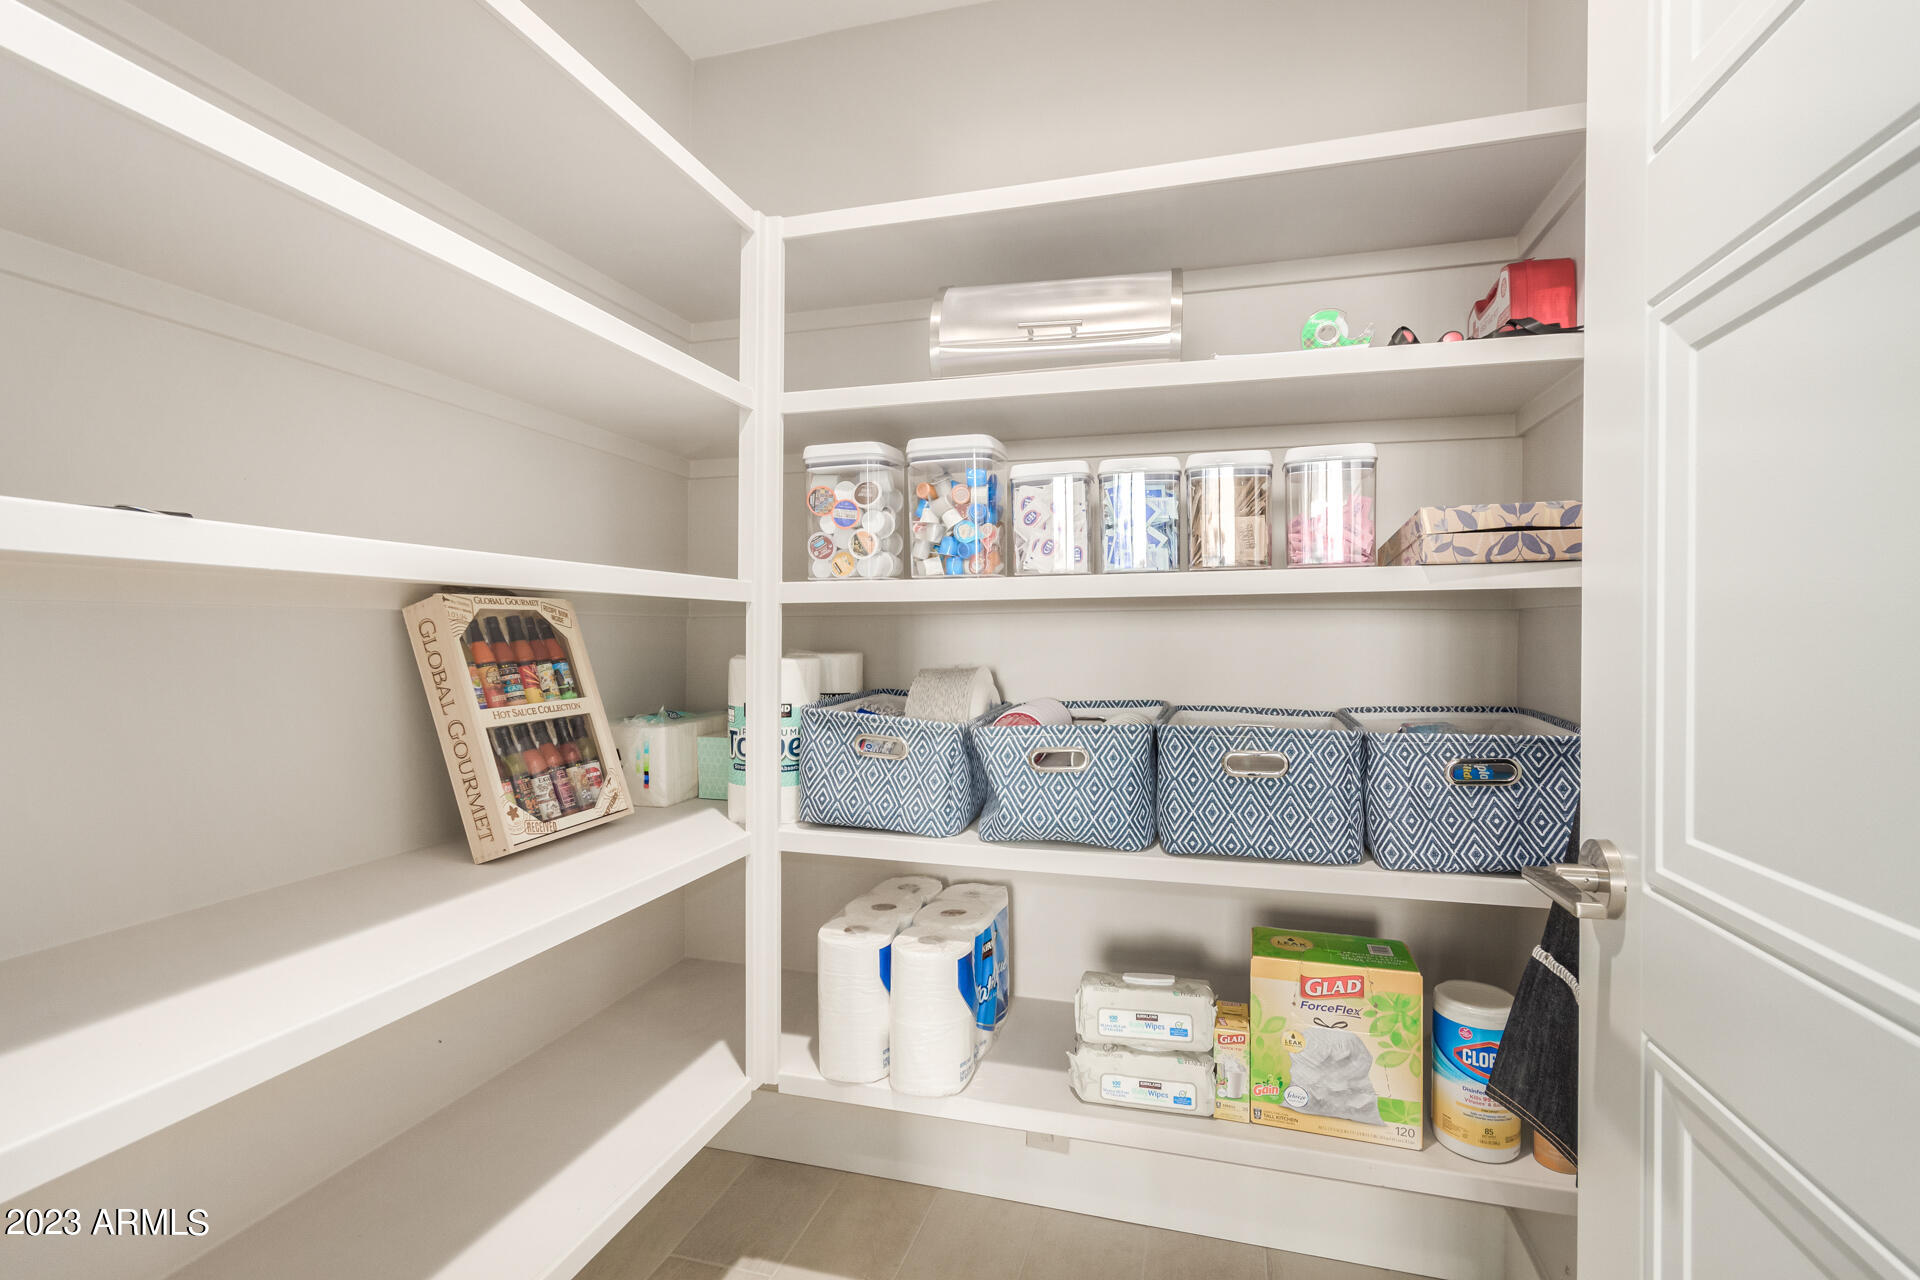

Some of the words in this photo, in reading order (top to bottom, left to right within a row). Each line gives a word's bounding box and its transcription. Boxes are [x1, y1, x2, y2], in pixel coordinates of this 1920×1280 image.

[473, 596, 504, 606] GLOBAL
[505, 597, 540, 607] GOURMET
[493, 709, 511, 720] HOT
[511, 707, 537, 717] SAUCE
[538, 702, 581, 715] COLLECTION
[418, 617, 456, 716] GLOBAL
[447, 719, 495, 842] GOURMET
[526, 821, 558, 833] RECEIVED
[1304, 978, 1362, 997] GLAD
[1300, 1000, 1364, 1017] ForceFlex
[1145, 1021, 1166, 1031] Wipes
[1219, 1034, 1244, 1044] GLAD
[1148, 1089, 1169, 1099] Wipes
[1253, 1084, 1279, 1097] Gain
[1395, 1126, 1416, 1138] 120
[1484, 1127, 1494, 1136] 85
